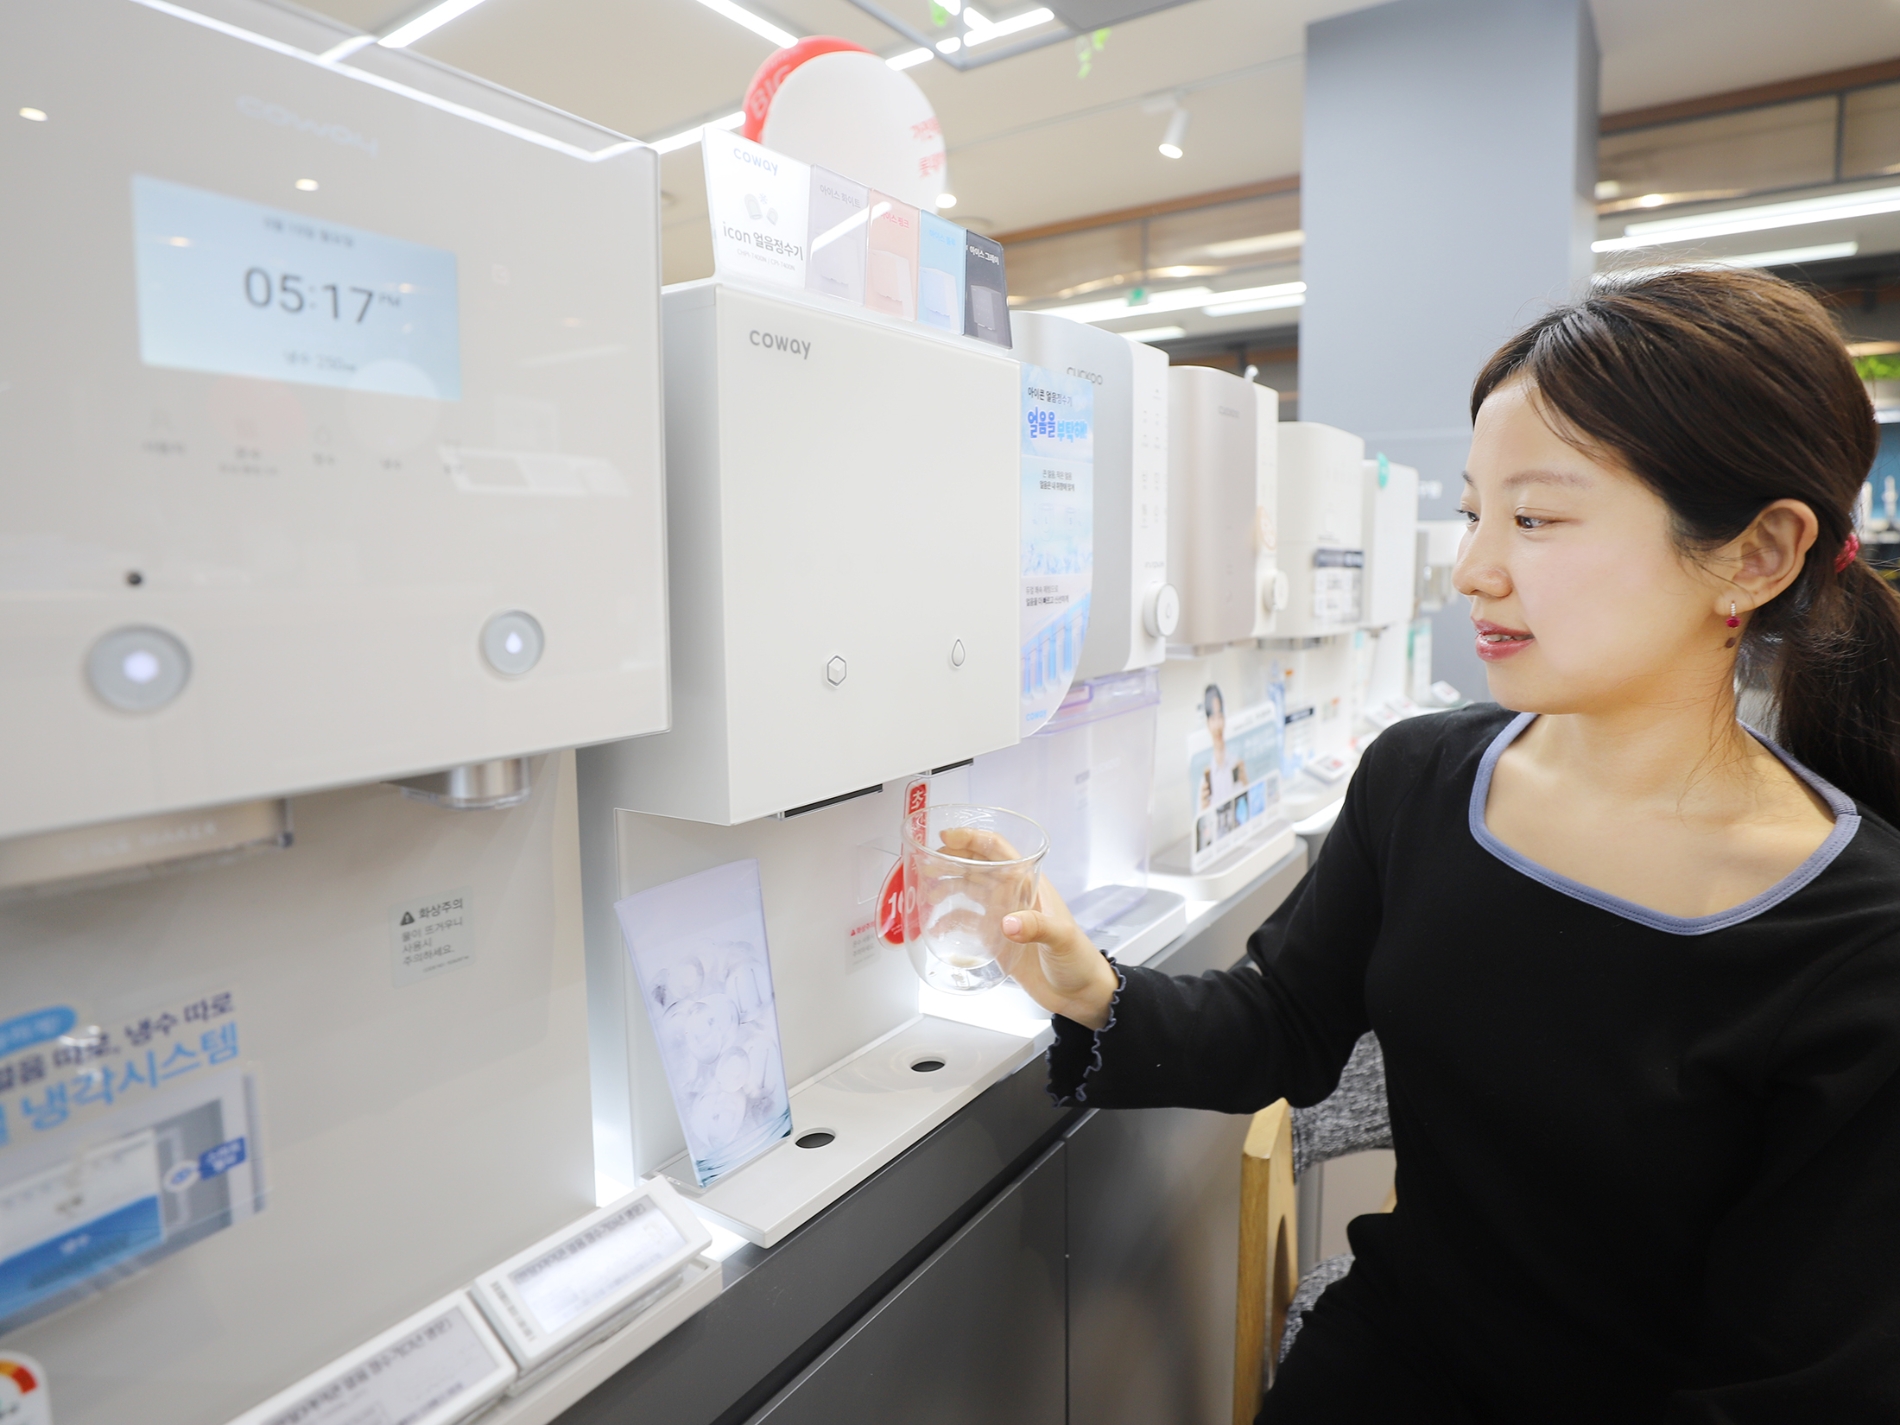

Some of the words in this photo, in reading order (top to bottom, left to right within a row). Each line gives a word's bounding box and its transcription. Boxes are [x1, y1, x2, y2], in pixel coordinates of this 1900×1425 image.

[733, 148, 778, 176] coway
[722, 221, 752, 245] icon
[753, 232, 804, 261] 얼음정수기
[243, 266, 375, 325] 05:17
[749, 329, 811, 360] coway
[1027, 387, 1045, 401] 아이콘
[1046, 390, 1073, 407] 얼음정수기
[1027, 406, 1056, 439] 얼음을
[419, 898, 463, 919] 화상주의
[402, 929, 422, 943] 물이
[425, 916, 463, 936] 뜨거우니
[124, 1011, 179, 1047] 냉수
[183, 991, 234, 1023] 따로
